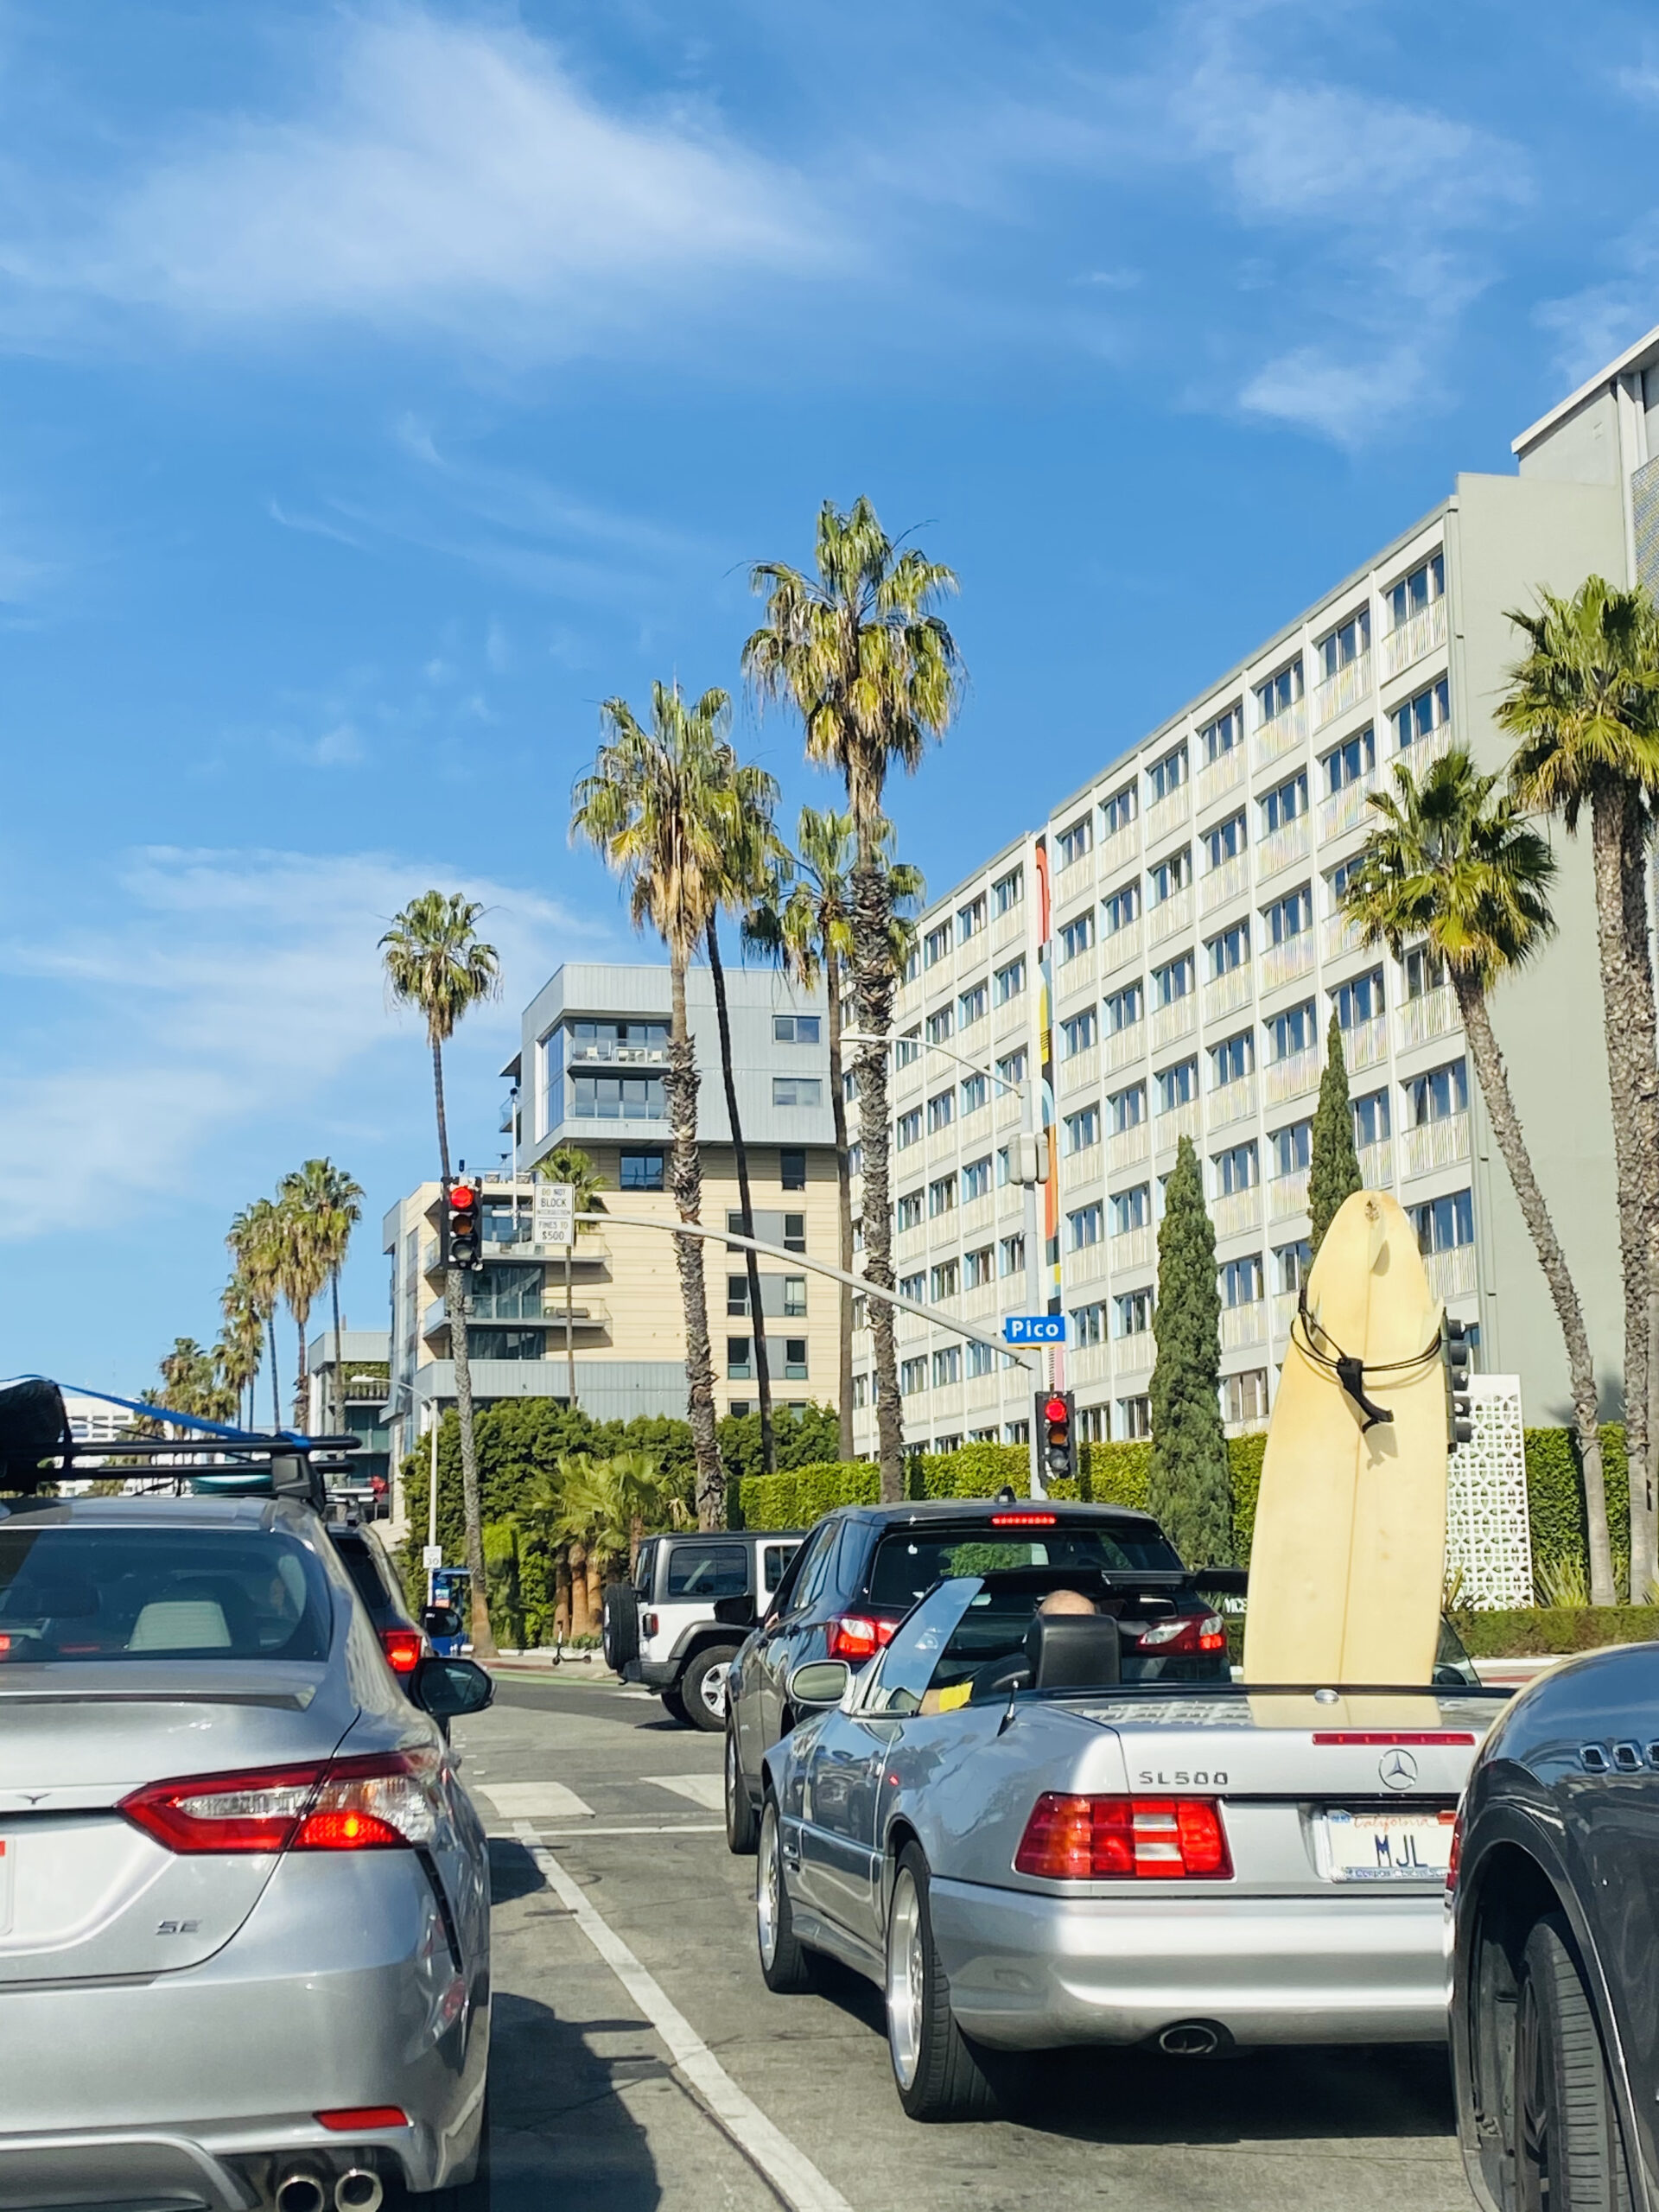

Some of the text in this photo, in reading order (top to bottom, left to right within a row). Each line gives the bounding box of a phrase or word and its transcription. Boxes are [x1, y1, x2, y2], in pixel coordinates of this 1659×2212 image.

[541, 1198, 567, 1207] BLOCK
[542, 1230, 564, 1241] $500
[1011, 1319, 1059, 1338] Pico
[426, 1557, 440, 1566] 30
[1139, 1771, 1229, 1785] SL500
[1353, 1815, 1438, 1834] California
[156, 1919, 203, 1936] SE
